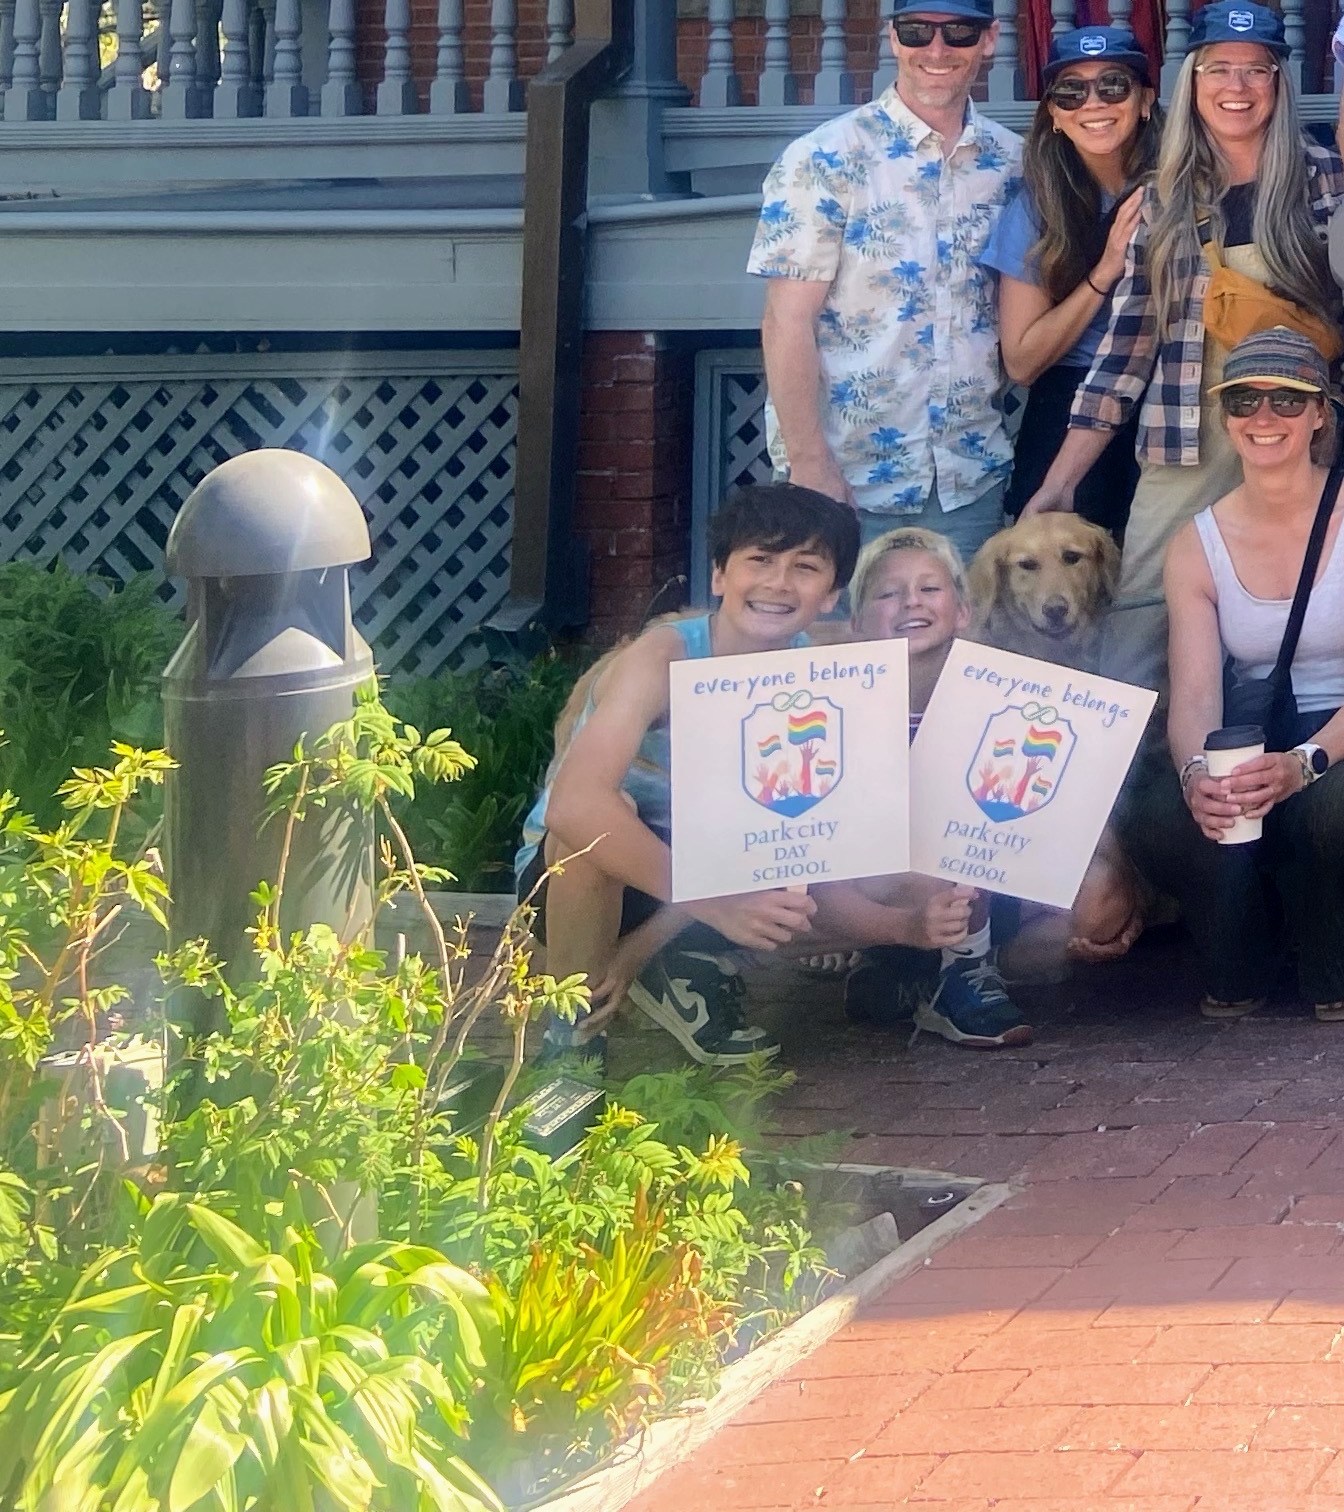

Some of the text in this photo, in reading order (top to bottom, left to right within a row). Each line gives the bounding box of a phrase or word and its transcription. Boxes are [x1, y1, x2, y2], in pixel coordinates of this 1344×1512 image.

[694, 661, 887, 699] everyone belongs
[963, 665, 1131, 729] everyone belongs
[743, 817, 839, 852] park city
[943, 820, 1032, 855] park city
[774, 843, 810, 861] DAY
[965, 844, 1000, 862] DAY
[752, 860, 832, 882] SCHOOL
[939, 855, 1008, 884] SCHOOL
